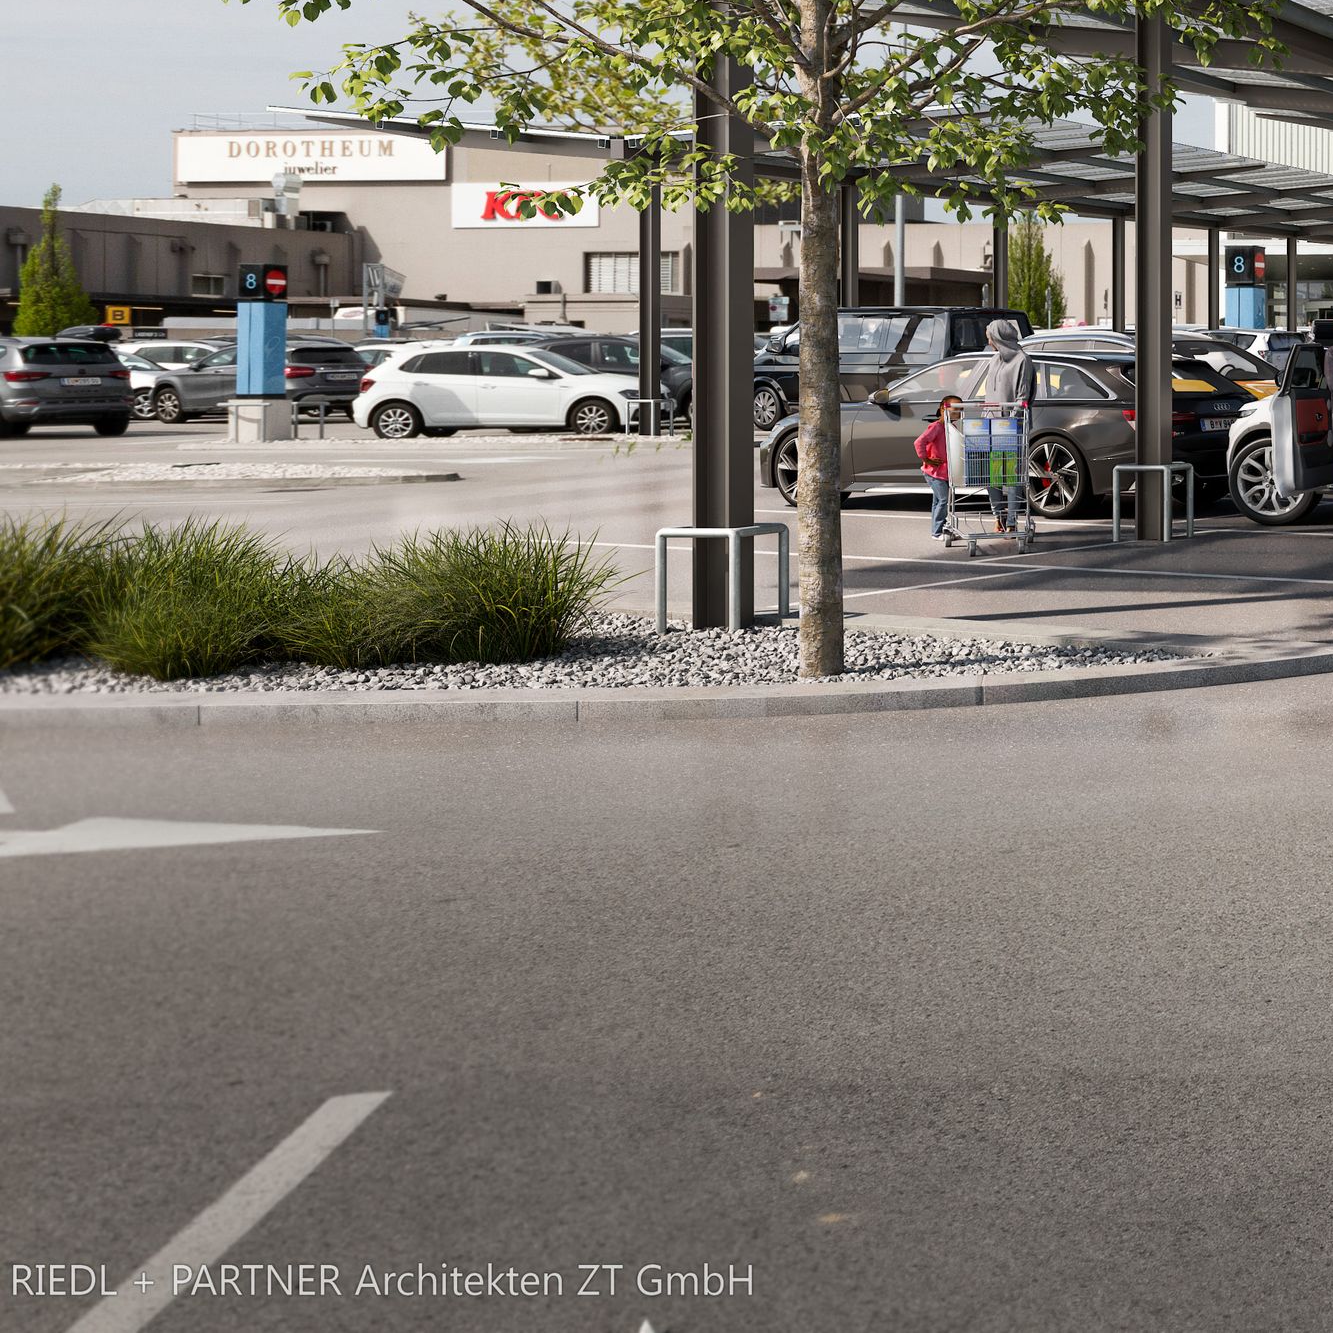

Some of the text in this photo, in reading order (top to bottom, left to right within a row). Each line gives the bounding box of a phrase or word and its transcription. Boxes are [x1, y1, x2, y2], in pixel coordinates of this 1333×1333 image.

[227, 139, 395, 158] DOROTHEUM
[1233, 256, 1245, 273] 8
[246, 273, 257, 289] 8
[1175, 294, 1182, 306] H
[112, 309, 125, 321] B
